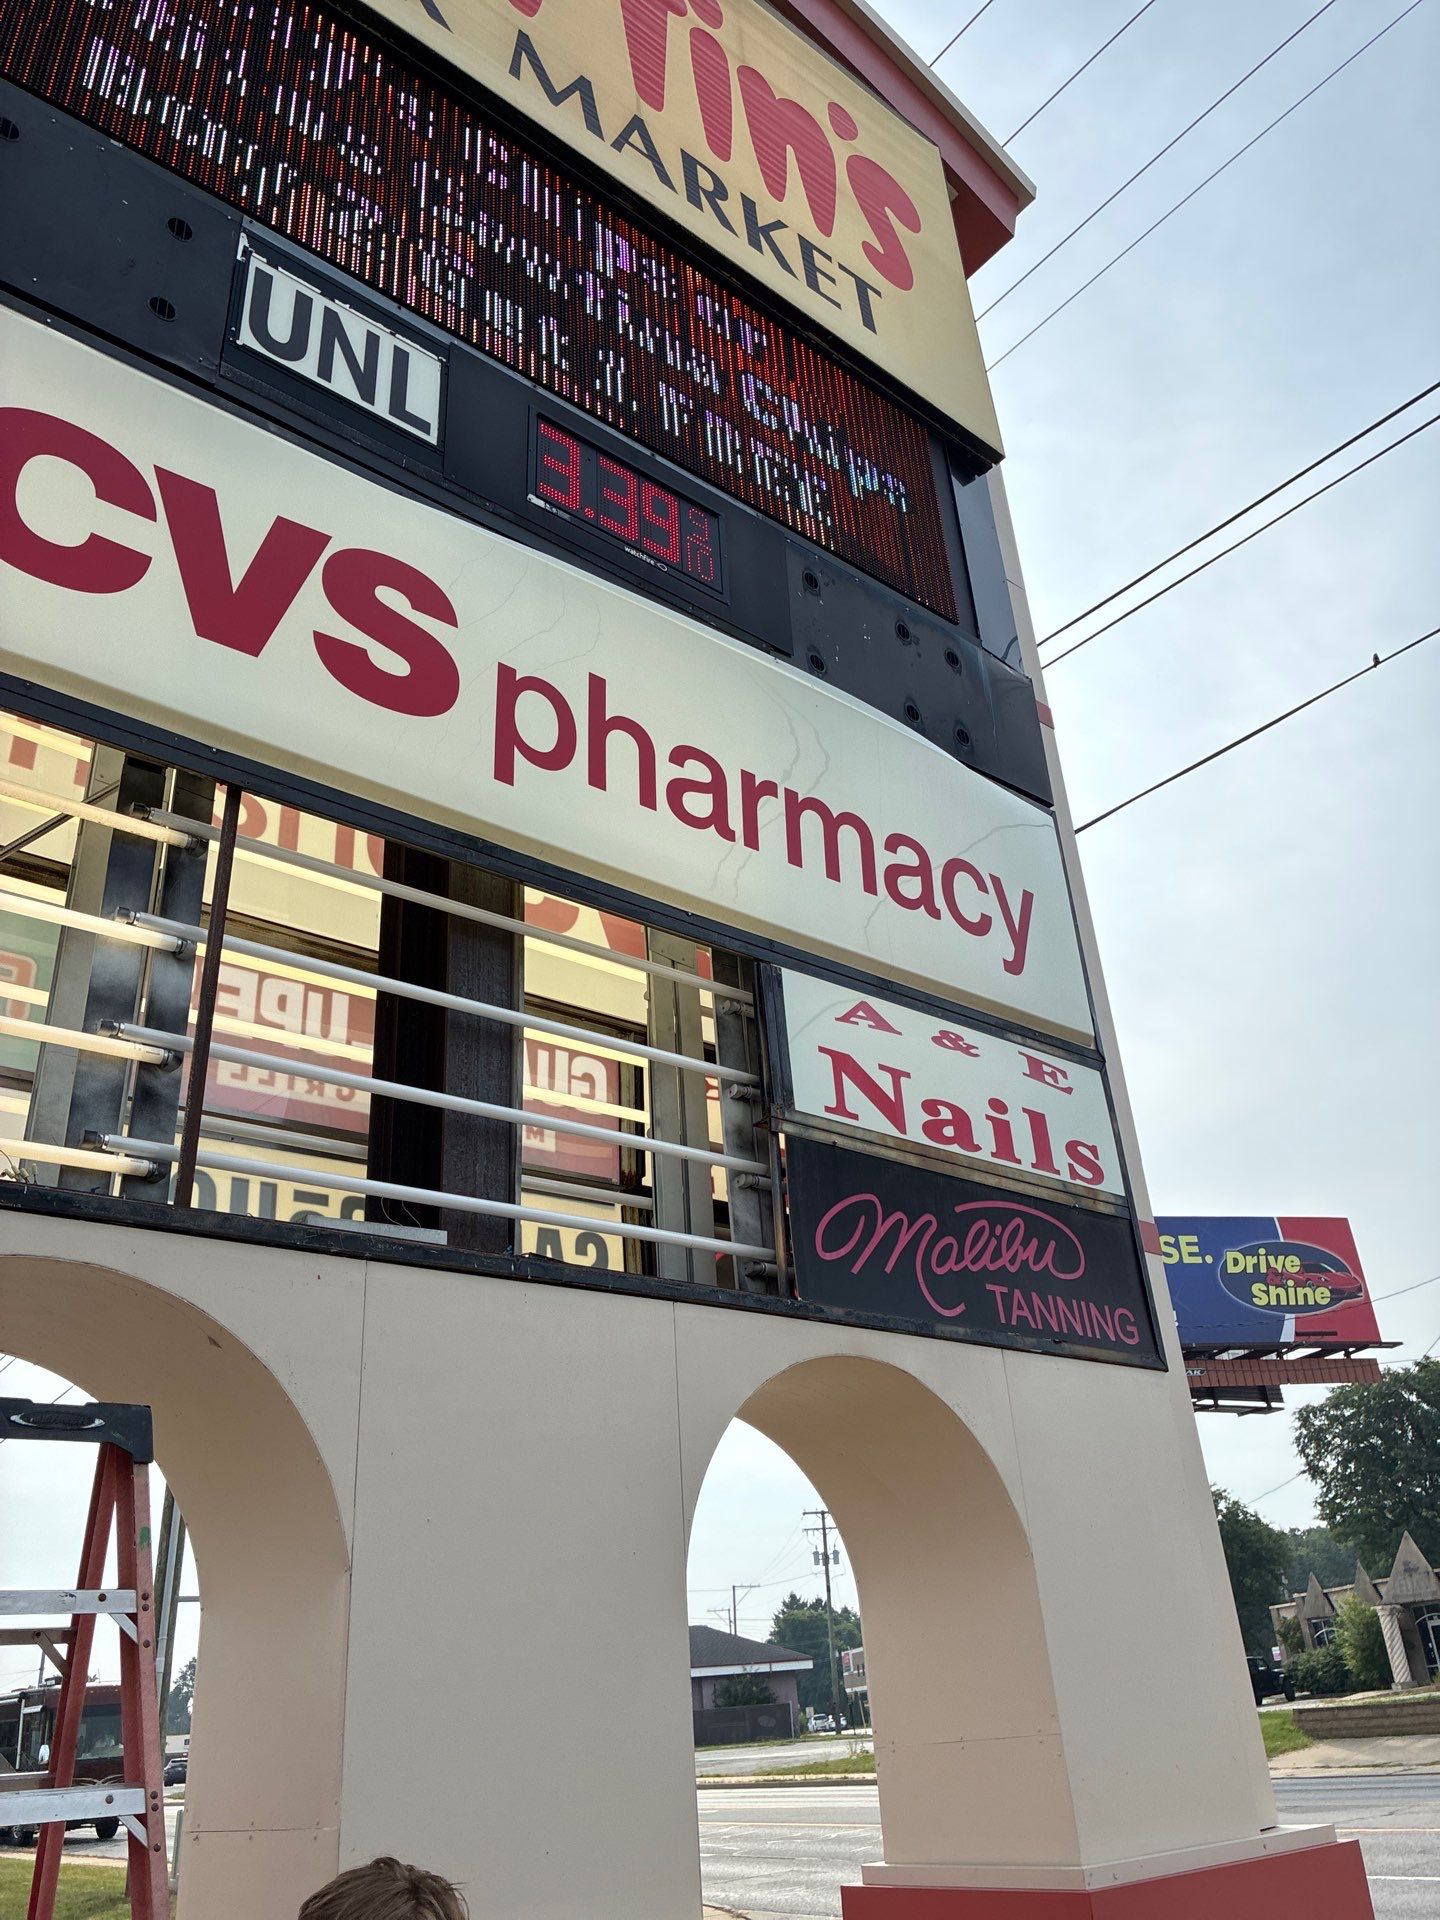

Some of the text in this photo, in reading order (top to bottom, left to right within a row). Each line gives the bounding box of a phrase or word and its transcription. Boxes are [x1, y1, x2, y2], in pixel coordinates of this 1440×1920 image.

[508, 29, 882, 335] MARKET
[248, 267, 432, 433] UNL
[540, 423, 680, 563] 3.39
[494, 662, 1033, 974] pharmacy
[836, 1001, 1074, 1095] A & E
[818, 1045, 1105, 1186] Nails
[815, 1193, 1086, 1318] Malibu
[986, 1283, 1140, 1345] TANNING
[1226, 1248, 1301, 1274] Drive
[1251, 1280, 1331, 1306] Shine
